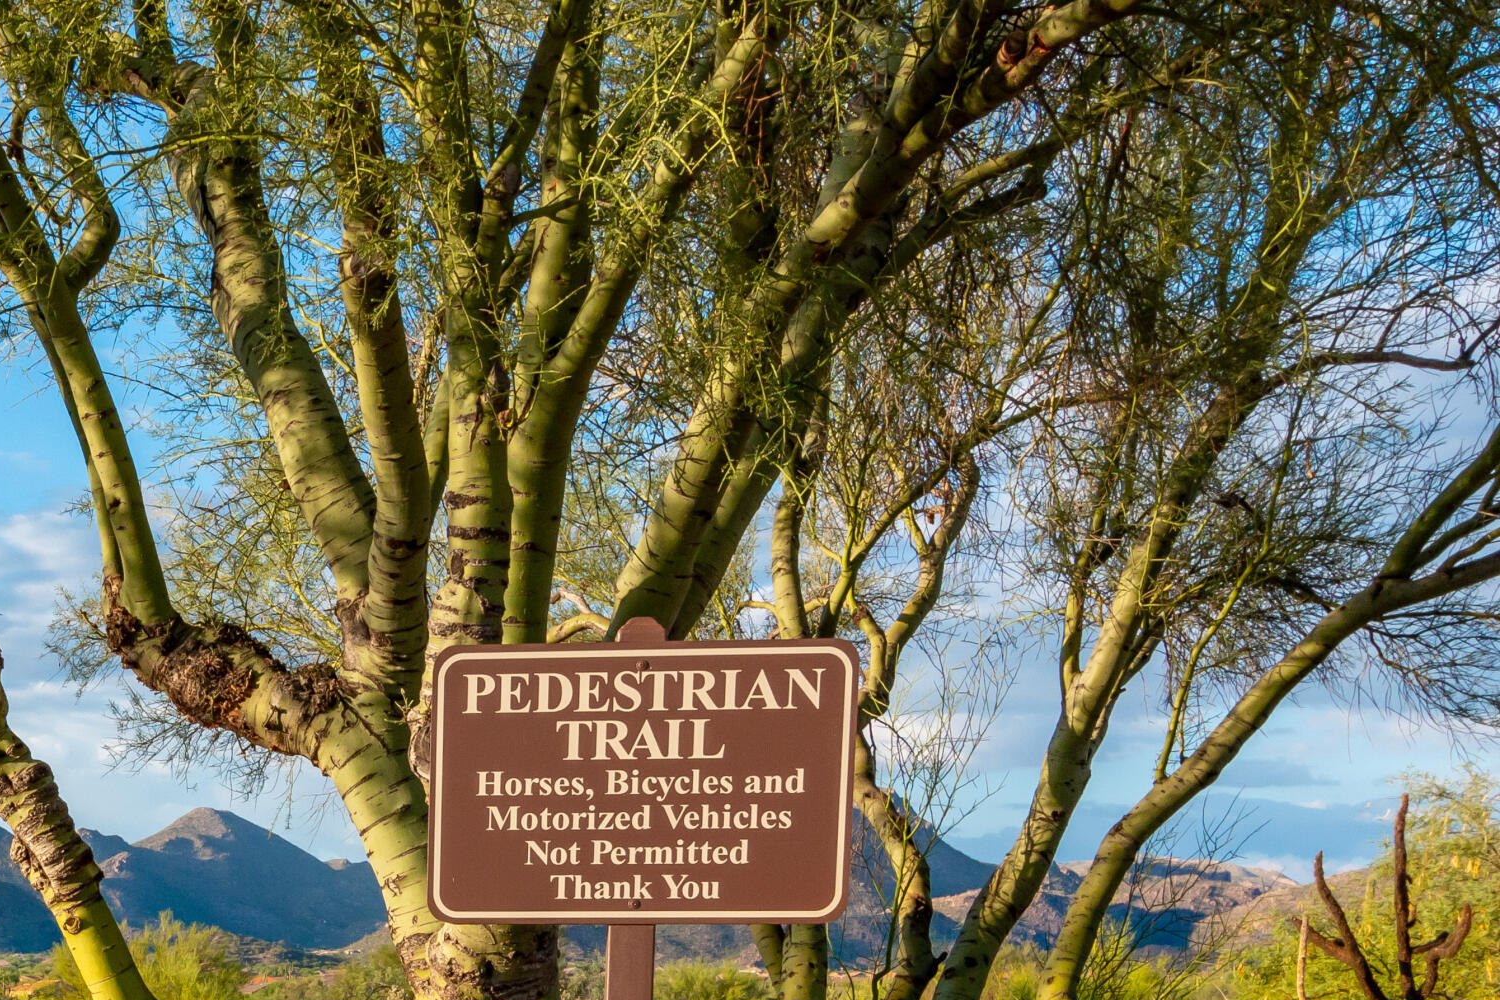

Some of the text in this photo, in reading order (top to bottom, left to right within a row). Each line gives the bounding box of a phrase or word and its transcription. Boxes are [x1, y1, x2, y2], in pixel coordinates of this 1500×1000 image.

[462, 668, 826, 714] PEDESTRIAN
[556, 719, 725, 761] TRAIL
[475, 768, 805, 801] Horses, Bicycles and
[486, 804, 792, 831] Motorized Vehicles
[524, 839, 749, 866] Not Permitted
[550, 874, 720, 900] Thank You
